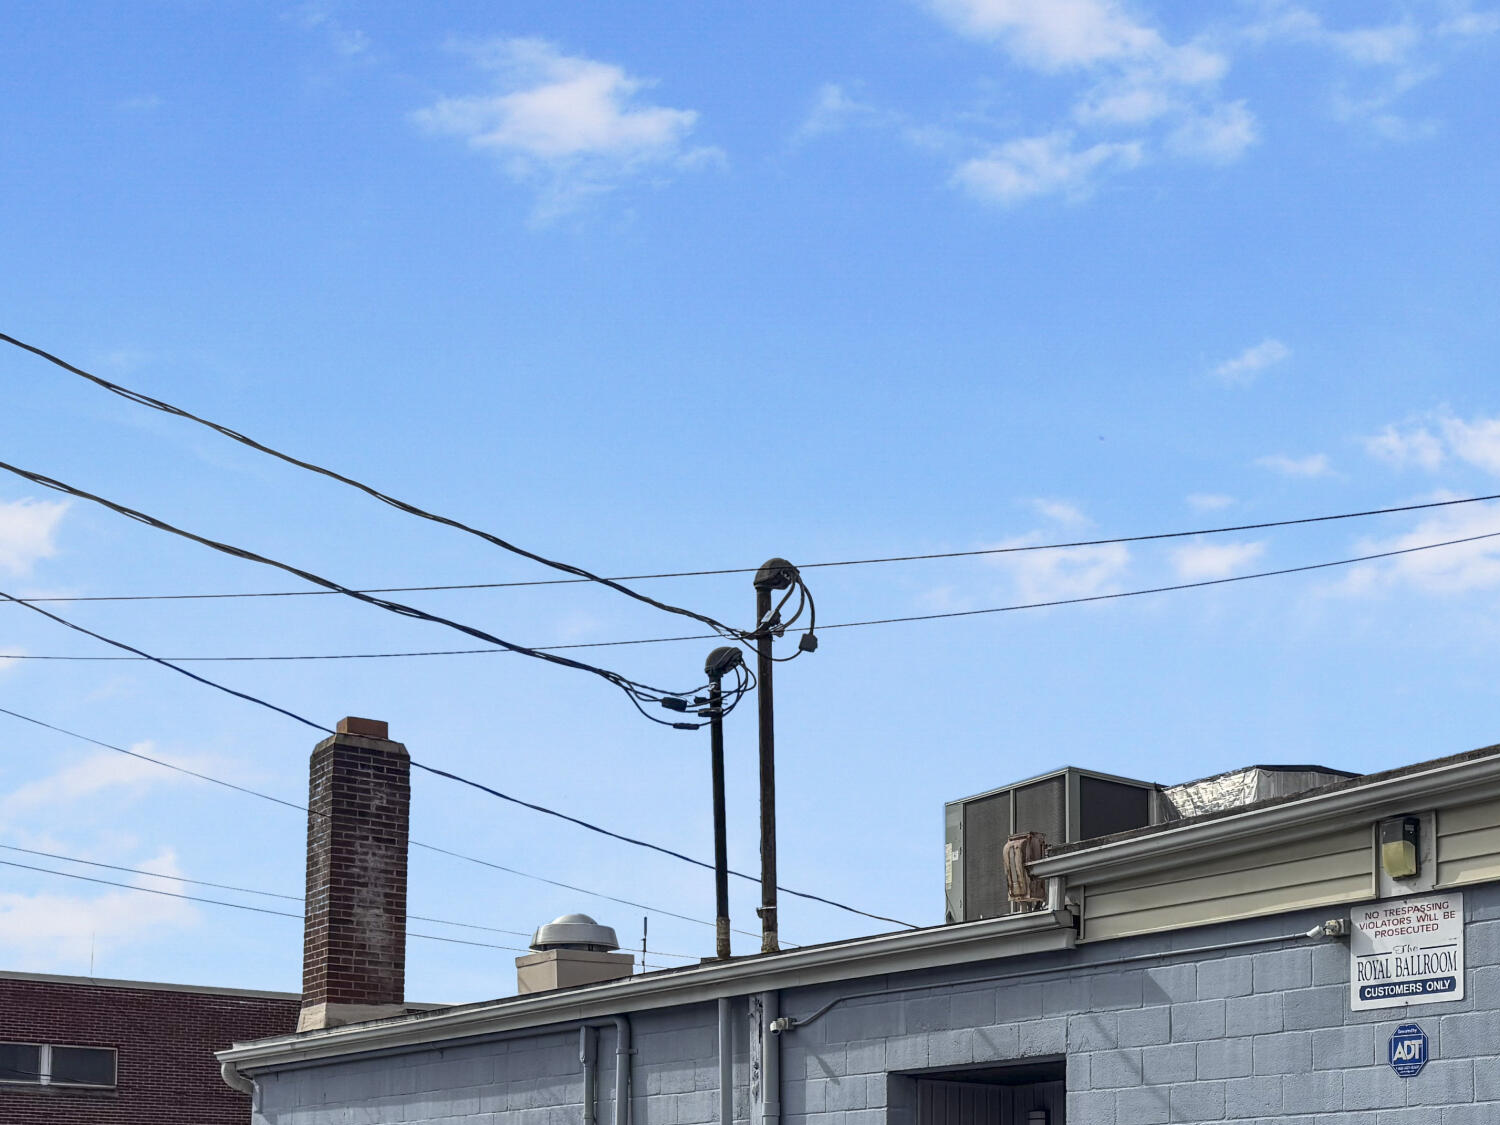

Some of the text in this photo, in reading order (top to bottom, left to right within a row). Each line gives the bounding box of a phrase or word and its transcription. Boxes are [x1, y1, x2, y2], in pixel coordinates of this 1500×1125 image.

[1364, 901, 1449, 920] NO TRESPASSING
[1359, 911, 1456, 931] VIOLATORS WILL BE
[1374, 923, 1439, 939] PROSECUTED
[1357, 950, 1458, 982] ROYAL BALLROOM
[1364, 979, 1451, 998] CUSTOMERS ONLY
[1393, 1039, 1423, 1061] ADT
